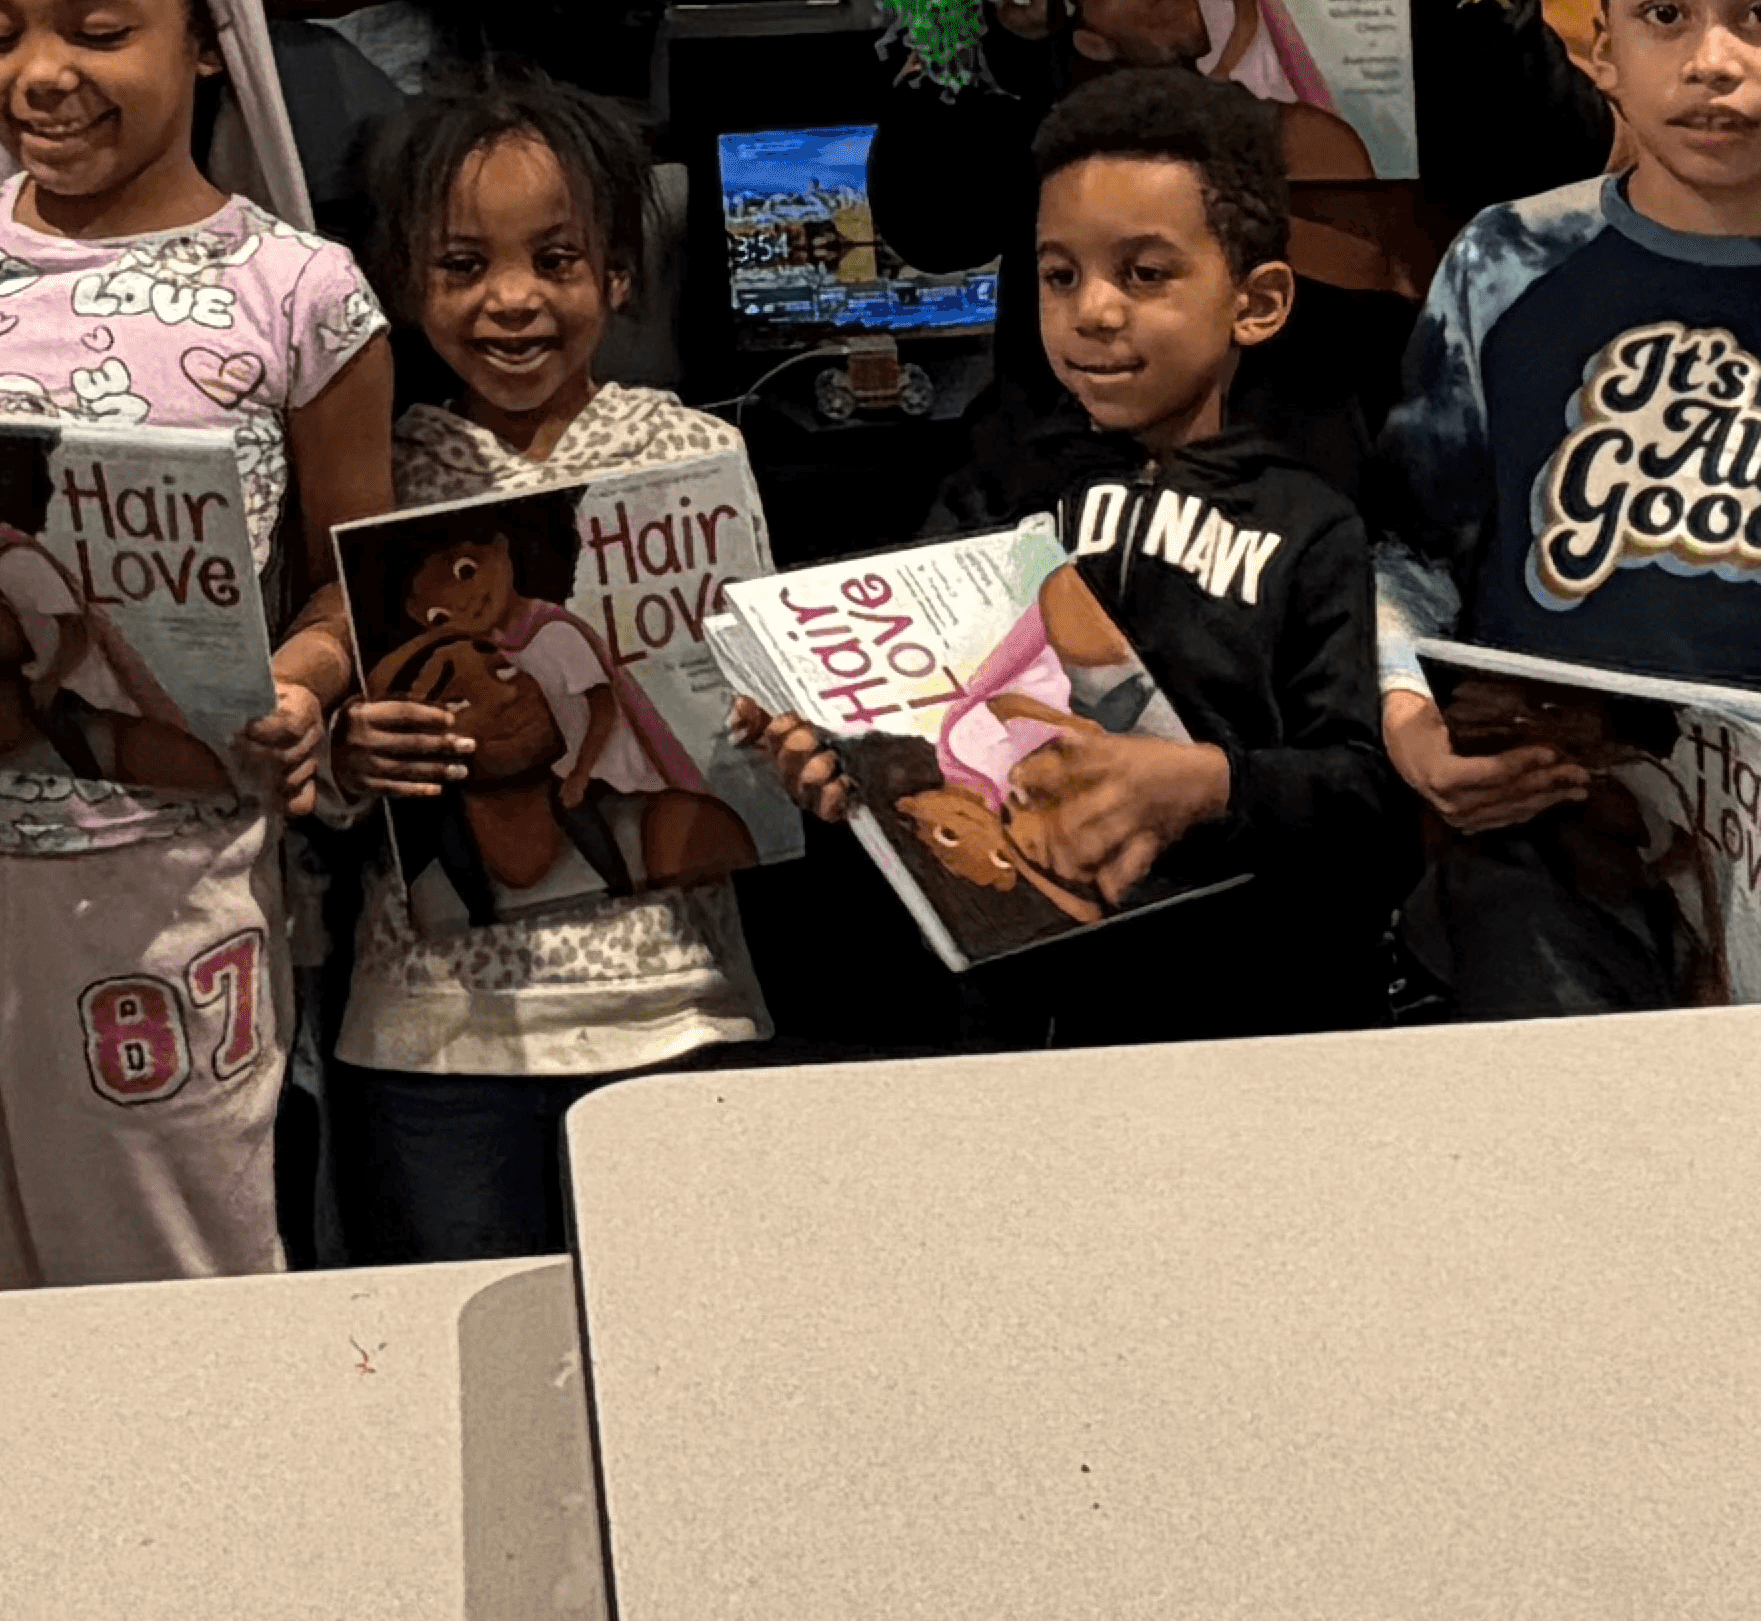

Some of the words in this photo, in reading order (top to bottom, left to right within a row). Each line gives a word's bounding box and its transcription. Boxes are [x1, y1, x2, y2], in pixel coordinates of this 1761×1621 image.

[71, 269, 238, 329] LOVE
[1599, 332, 1753, 414] It's
[61, 461, 230, 543] Hair
[587, 495, 738, 585] Hair
[74, 537, 240, 608] Love
[1142, 489, 1282, 606] NAVY
[779, 585, 903, 726] Hair
[840, 572, 971, 712] Love
[76, 925, 265, 1108] 87
